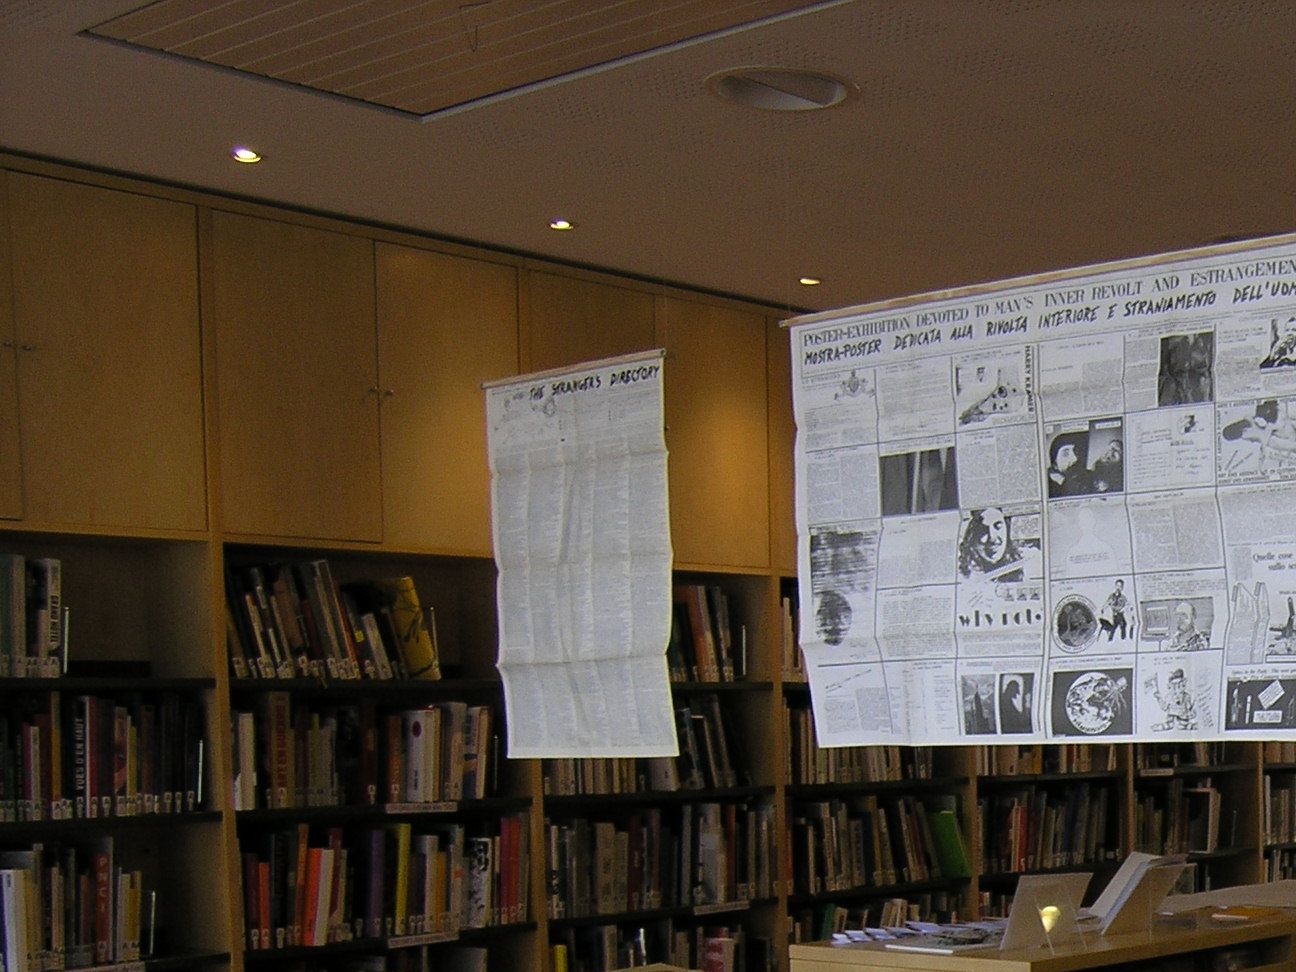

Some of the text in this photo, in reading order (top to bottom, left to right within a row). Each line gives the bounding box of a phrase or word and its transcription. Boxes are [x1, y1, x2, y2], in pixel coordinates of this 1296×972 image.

[803, 315, 911, 346] POSTER-EXHIBITION
[916, 309, 969, 328] DEVOTED
[975, 304, 990, 318] TO
[993, 295, 1034, 315] MAN'S
[1044, 289, 1085, 307] INNER
[1091, 280, 1144, 300] REVOLT
[1152, 275, 1180, 293] AND
[803, 338, 882, 366] MOSTRA-POSTER
[893, 328, 942, 351] DEDICATA
[950, 324, 973, 340] ALLA
[985, 316, 1028, 337] RIVOLTA
[1037, 304, 1100, 329] INTERIORE
[1107, 303, 1118, 320] E
[1123, 291, 1217, 318] STRANIAMENTO
[610, 365, 660, 386] DIRECTORY
